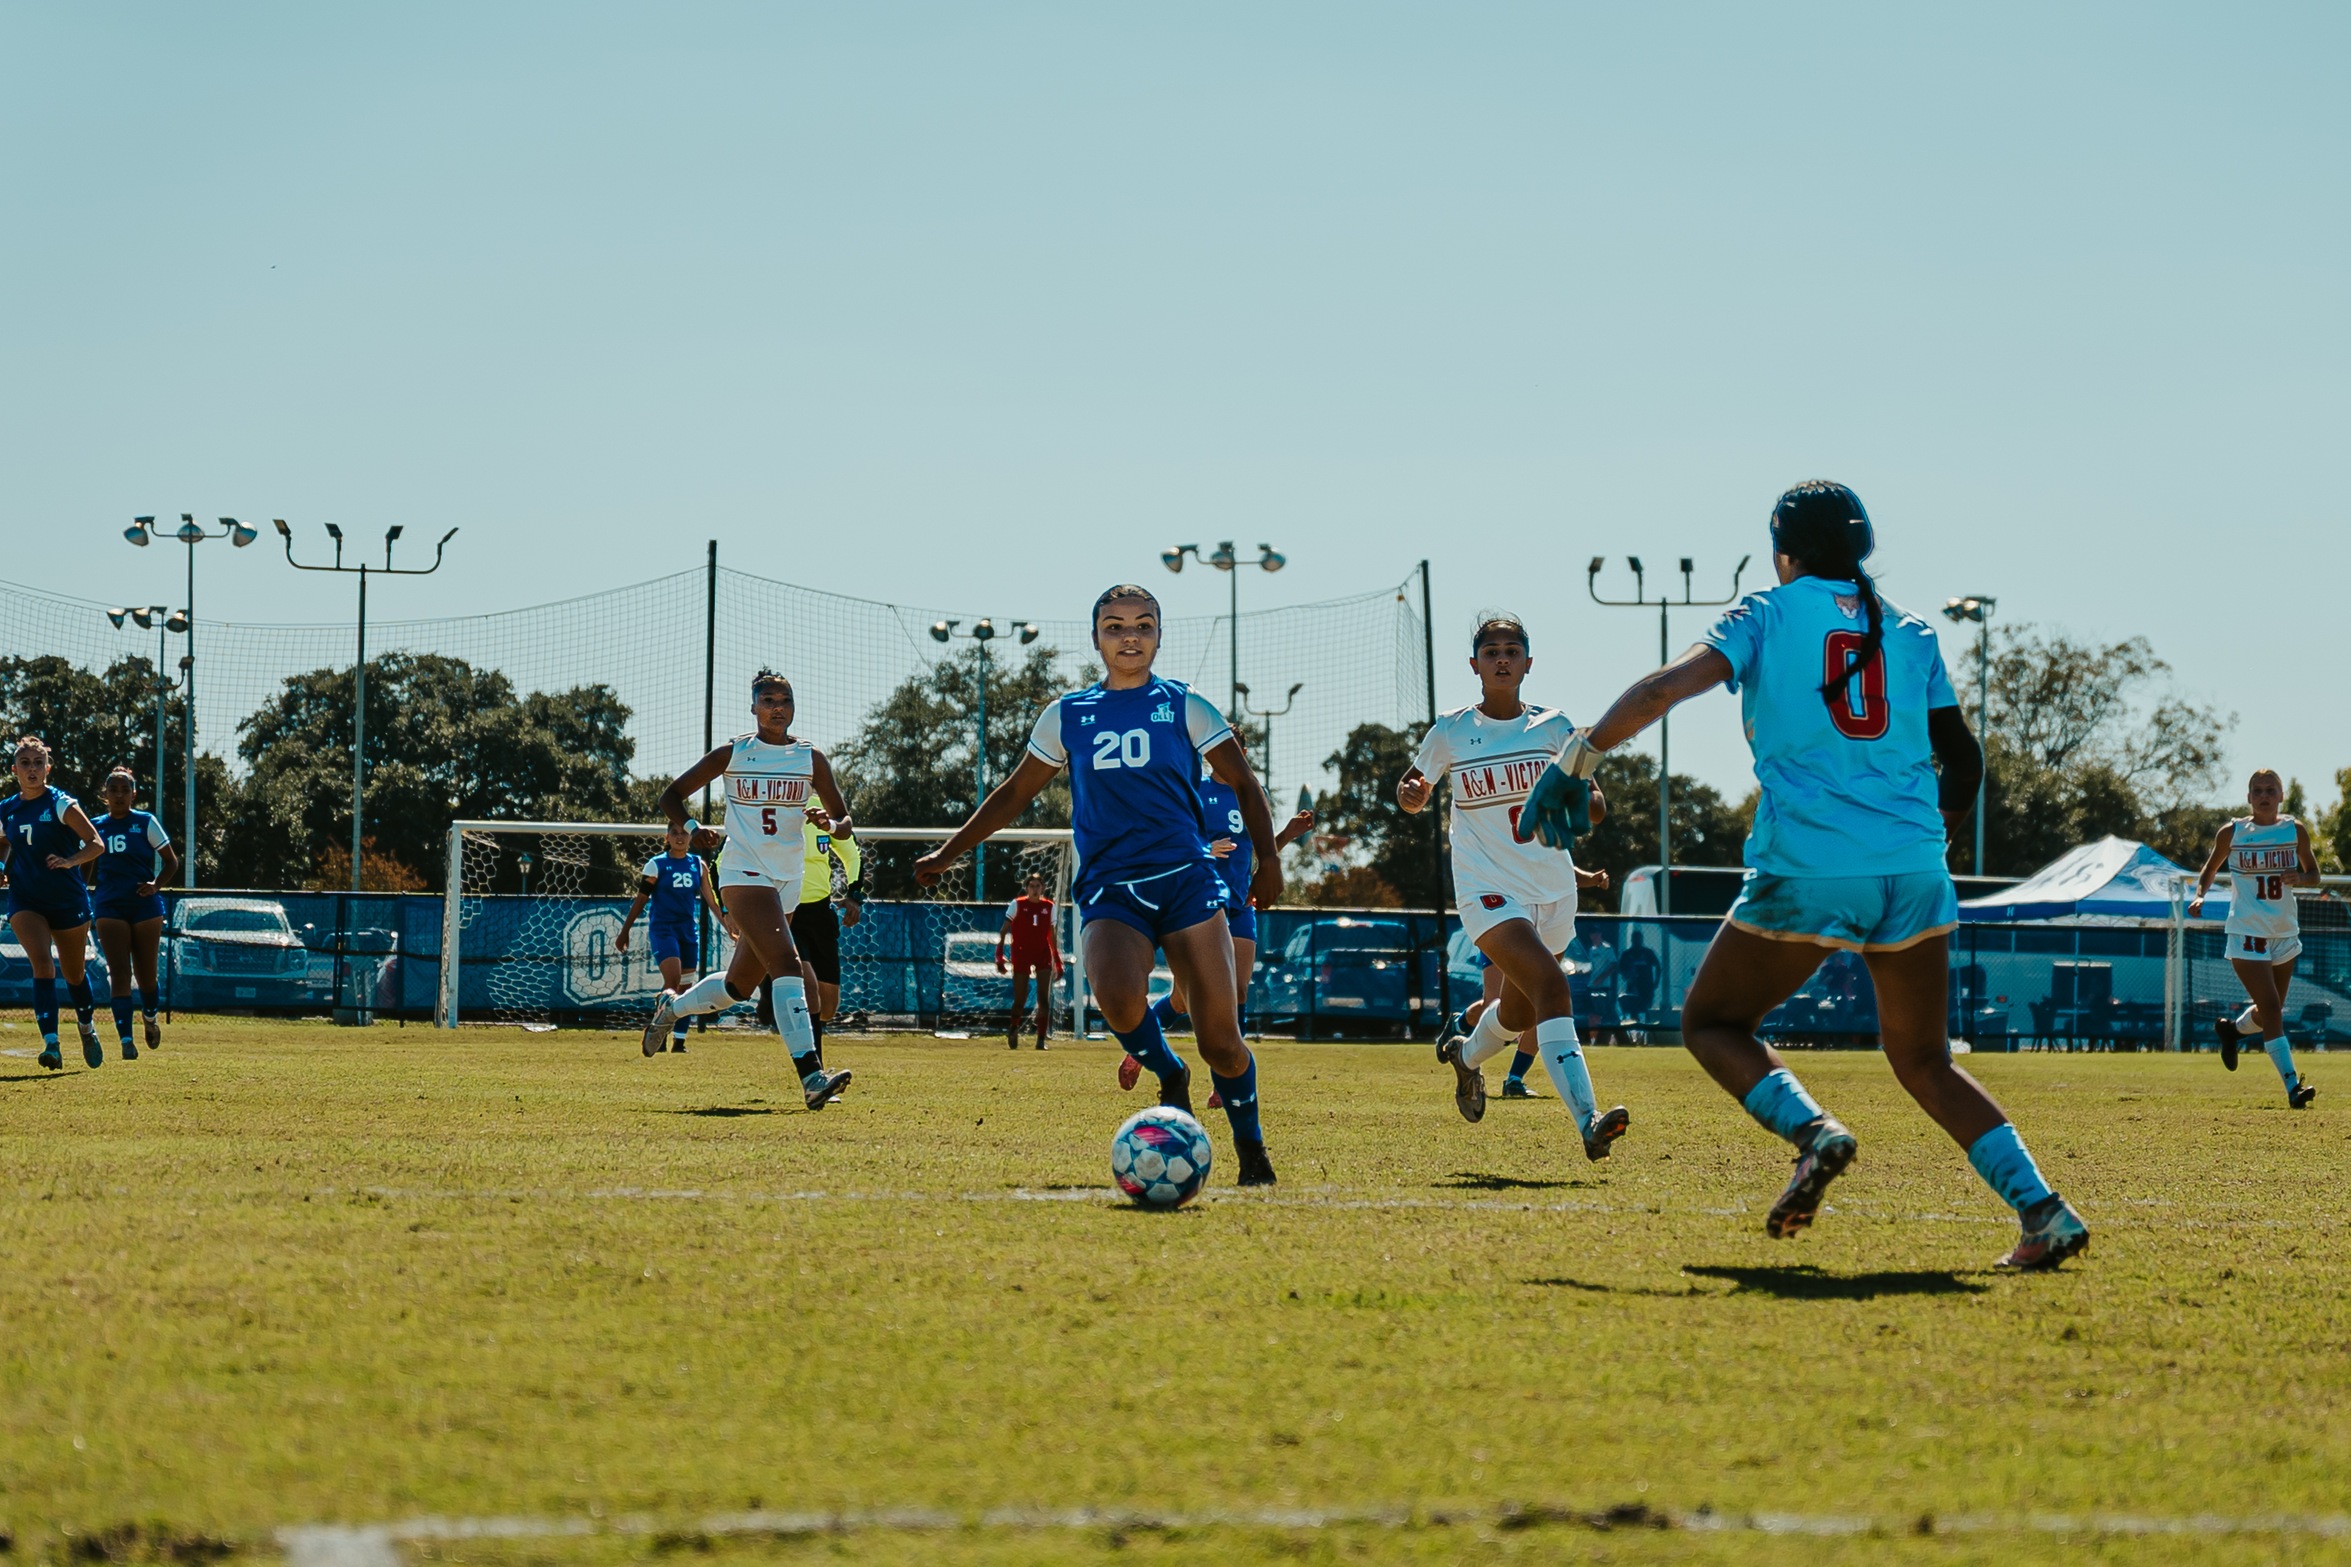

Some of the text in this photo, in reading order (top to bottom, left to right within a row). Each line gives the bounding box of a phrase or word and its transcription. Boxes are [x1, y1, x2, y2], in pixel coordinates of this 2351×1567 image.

[1823, 628, 1890, 742] 0
[1093, 728, 1150, 770] 20
[761, 808, 778, 836] 5
[1228, 809, 1244, 834] 9
[19, 824, 33, 846] 7
[107, 834, 127, 853] 16
[672, 872, 693, 888] 26
[2256, 875, 2283, 900] 18
[1032, 914, 1038, 926] 1
